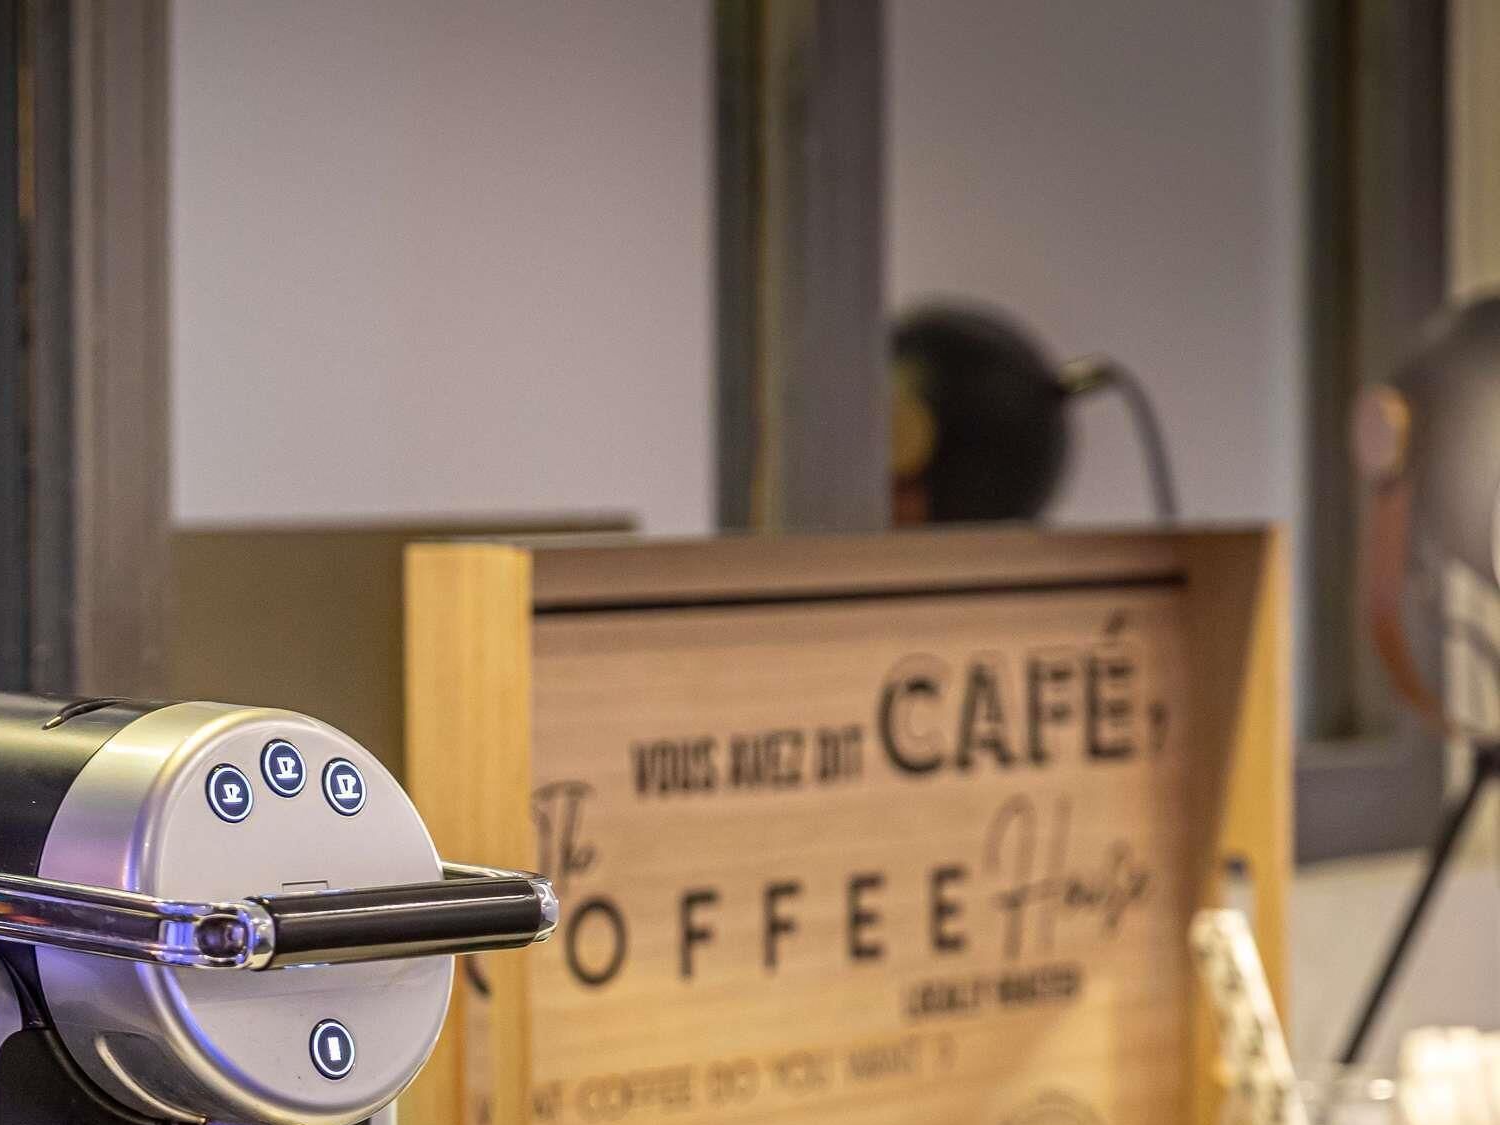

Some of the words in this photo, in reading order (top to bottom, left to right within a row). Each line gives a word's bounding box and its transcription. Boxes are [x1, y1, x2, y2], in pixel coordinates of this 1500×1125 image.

[630, 738, 719, 798] VOUS
[728, 730, 804, 791] AVEZ
[816, 723, 864, 786] DIT
